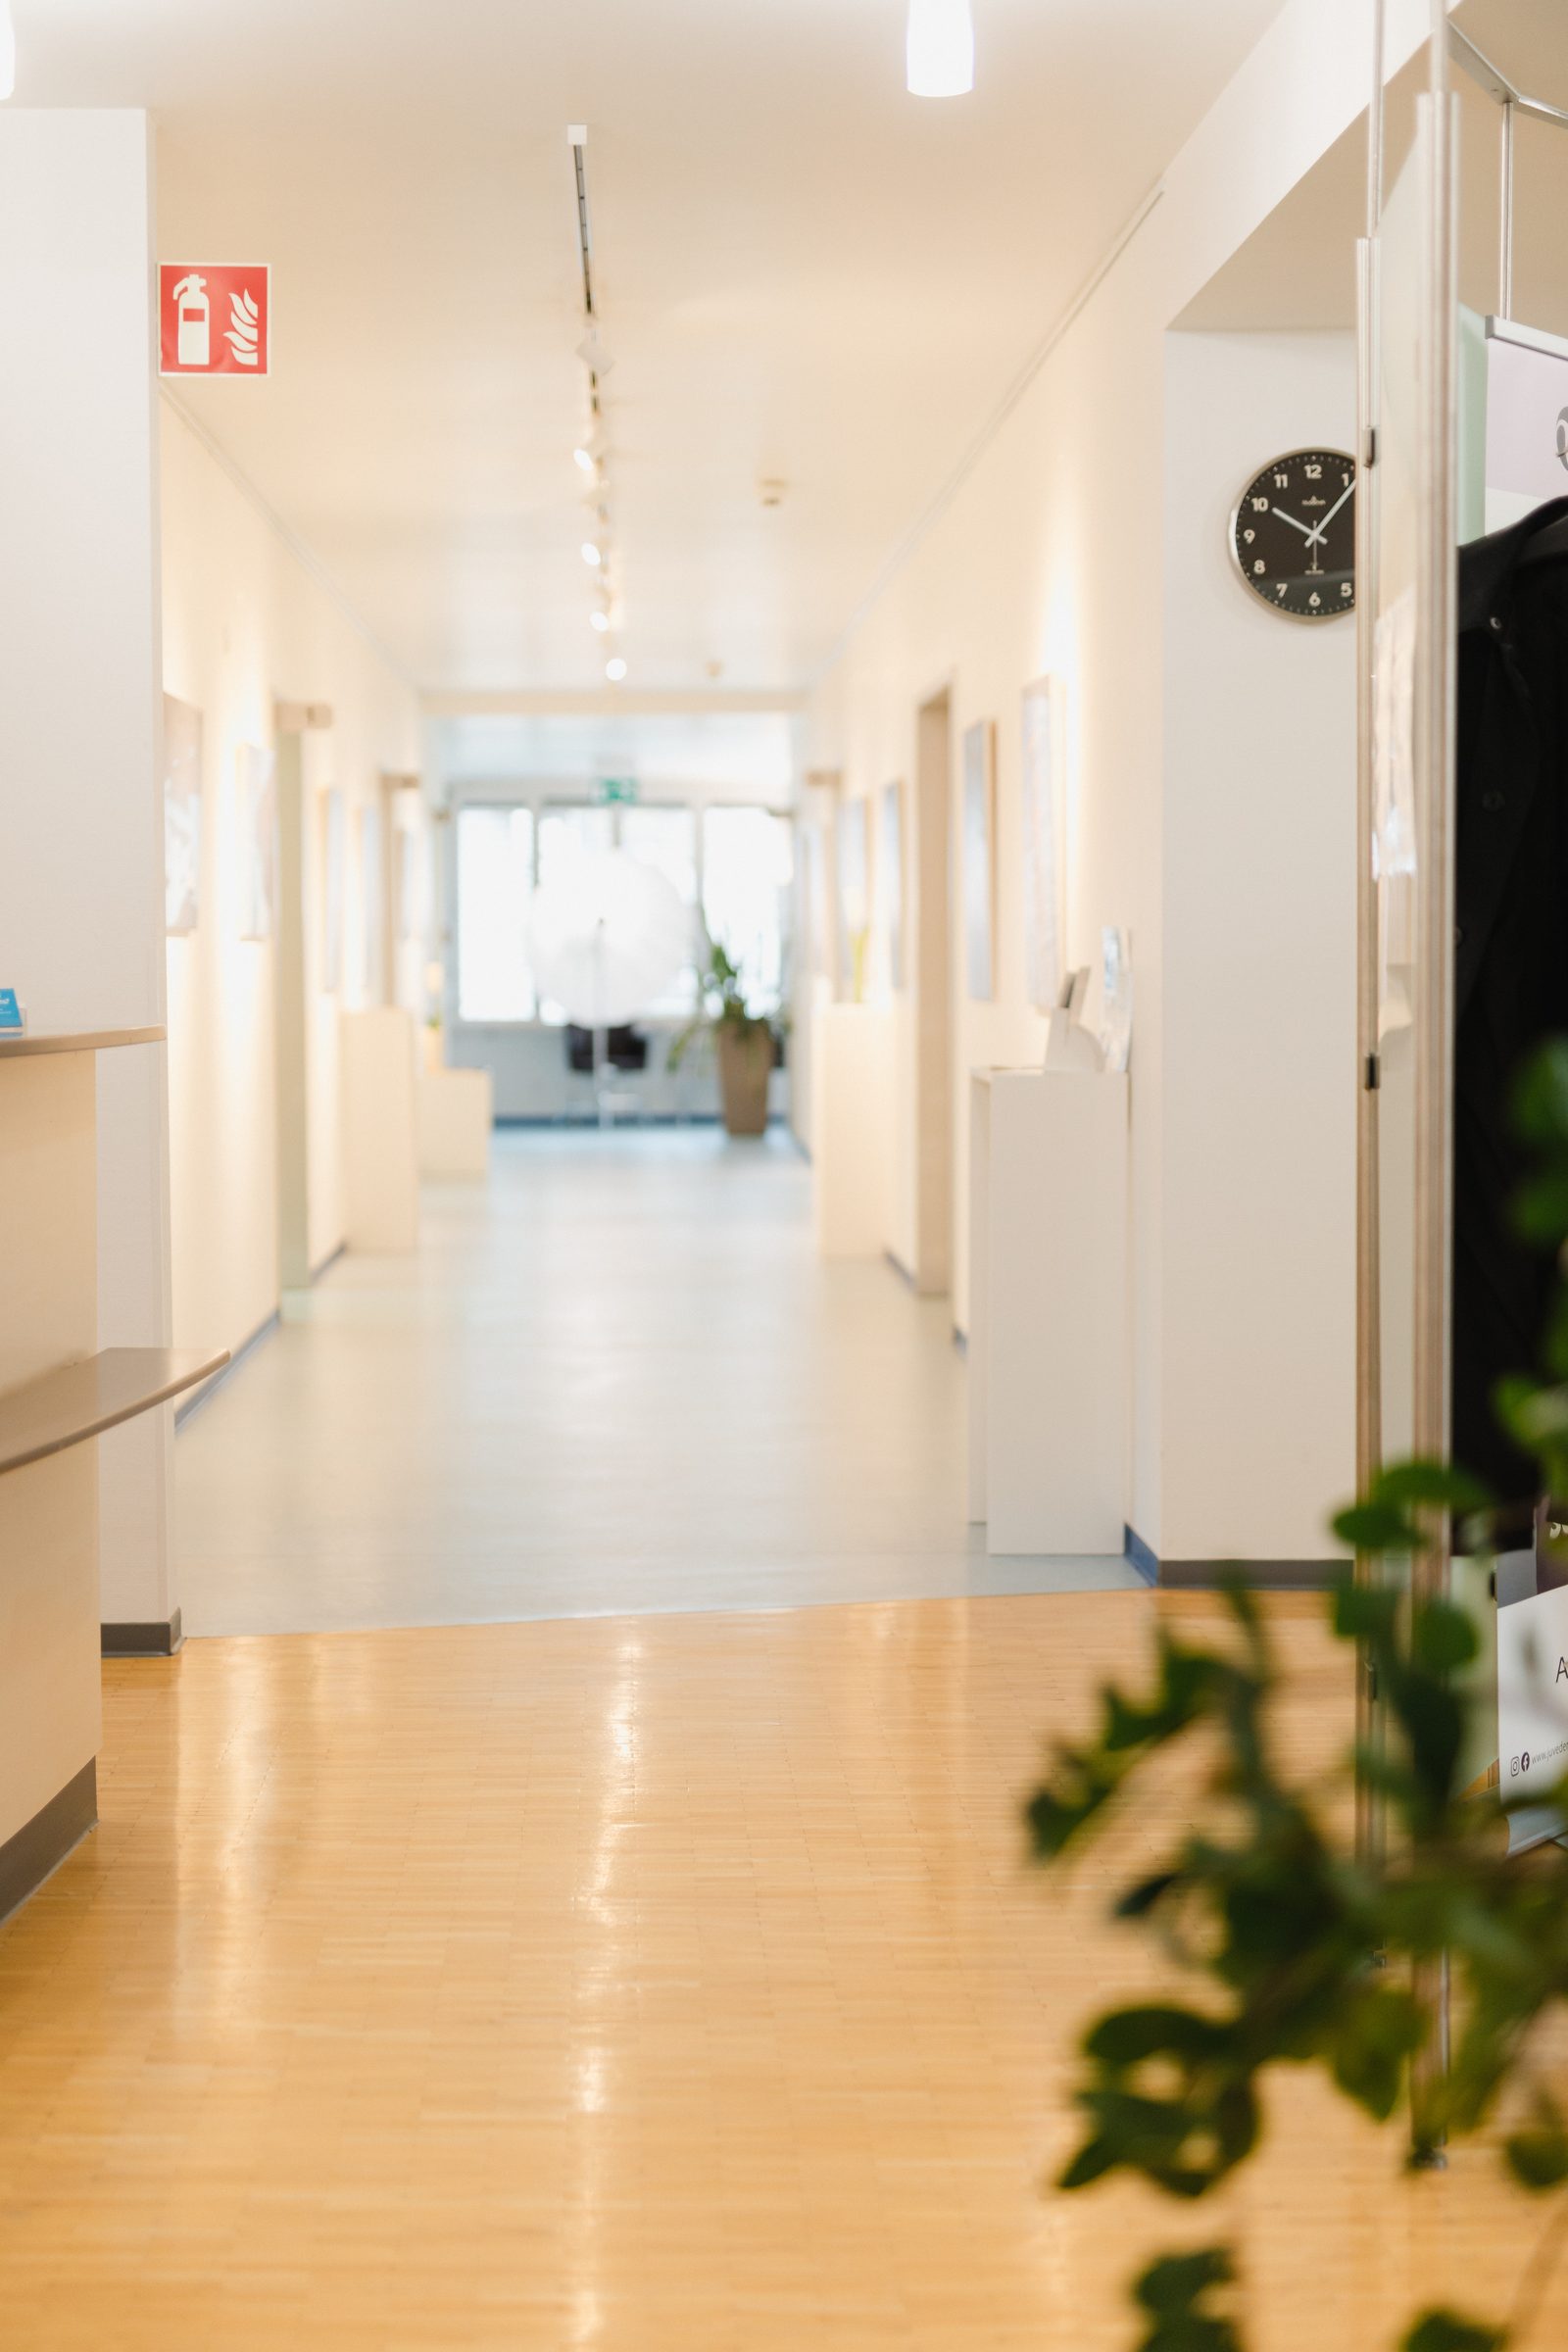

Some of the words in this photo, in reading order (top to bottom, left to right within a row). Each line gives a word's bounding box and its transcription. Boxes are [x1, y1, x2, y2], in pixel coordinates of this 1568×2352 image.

[1304, 465, 1322, 478] 12
[1274, 474, 1288, 488] 11
[1342, 473, 1348, 487] 1
[1251, 498, 1268, 512] 10
[1244, 529, 1255, 543] 9
[1253, 560, 1265, 574] 8
[1277, 583, 1288, 597] 7
[1341, 583, 1352, 597] 5
[1309, 592, 1320, 607] 6
